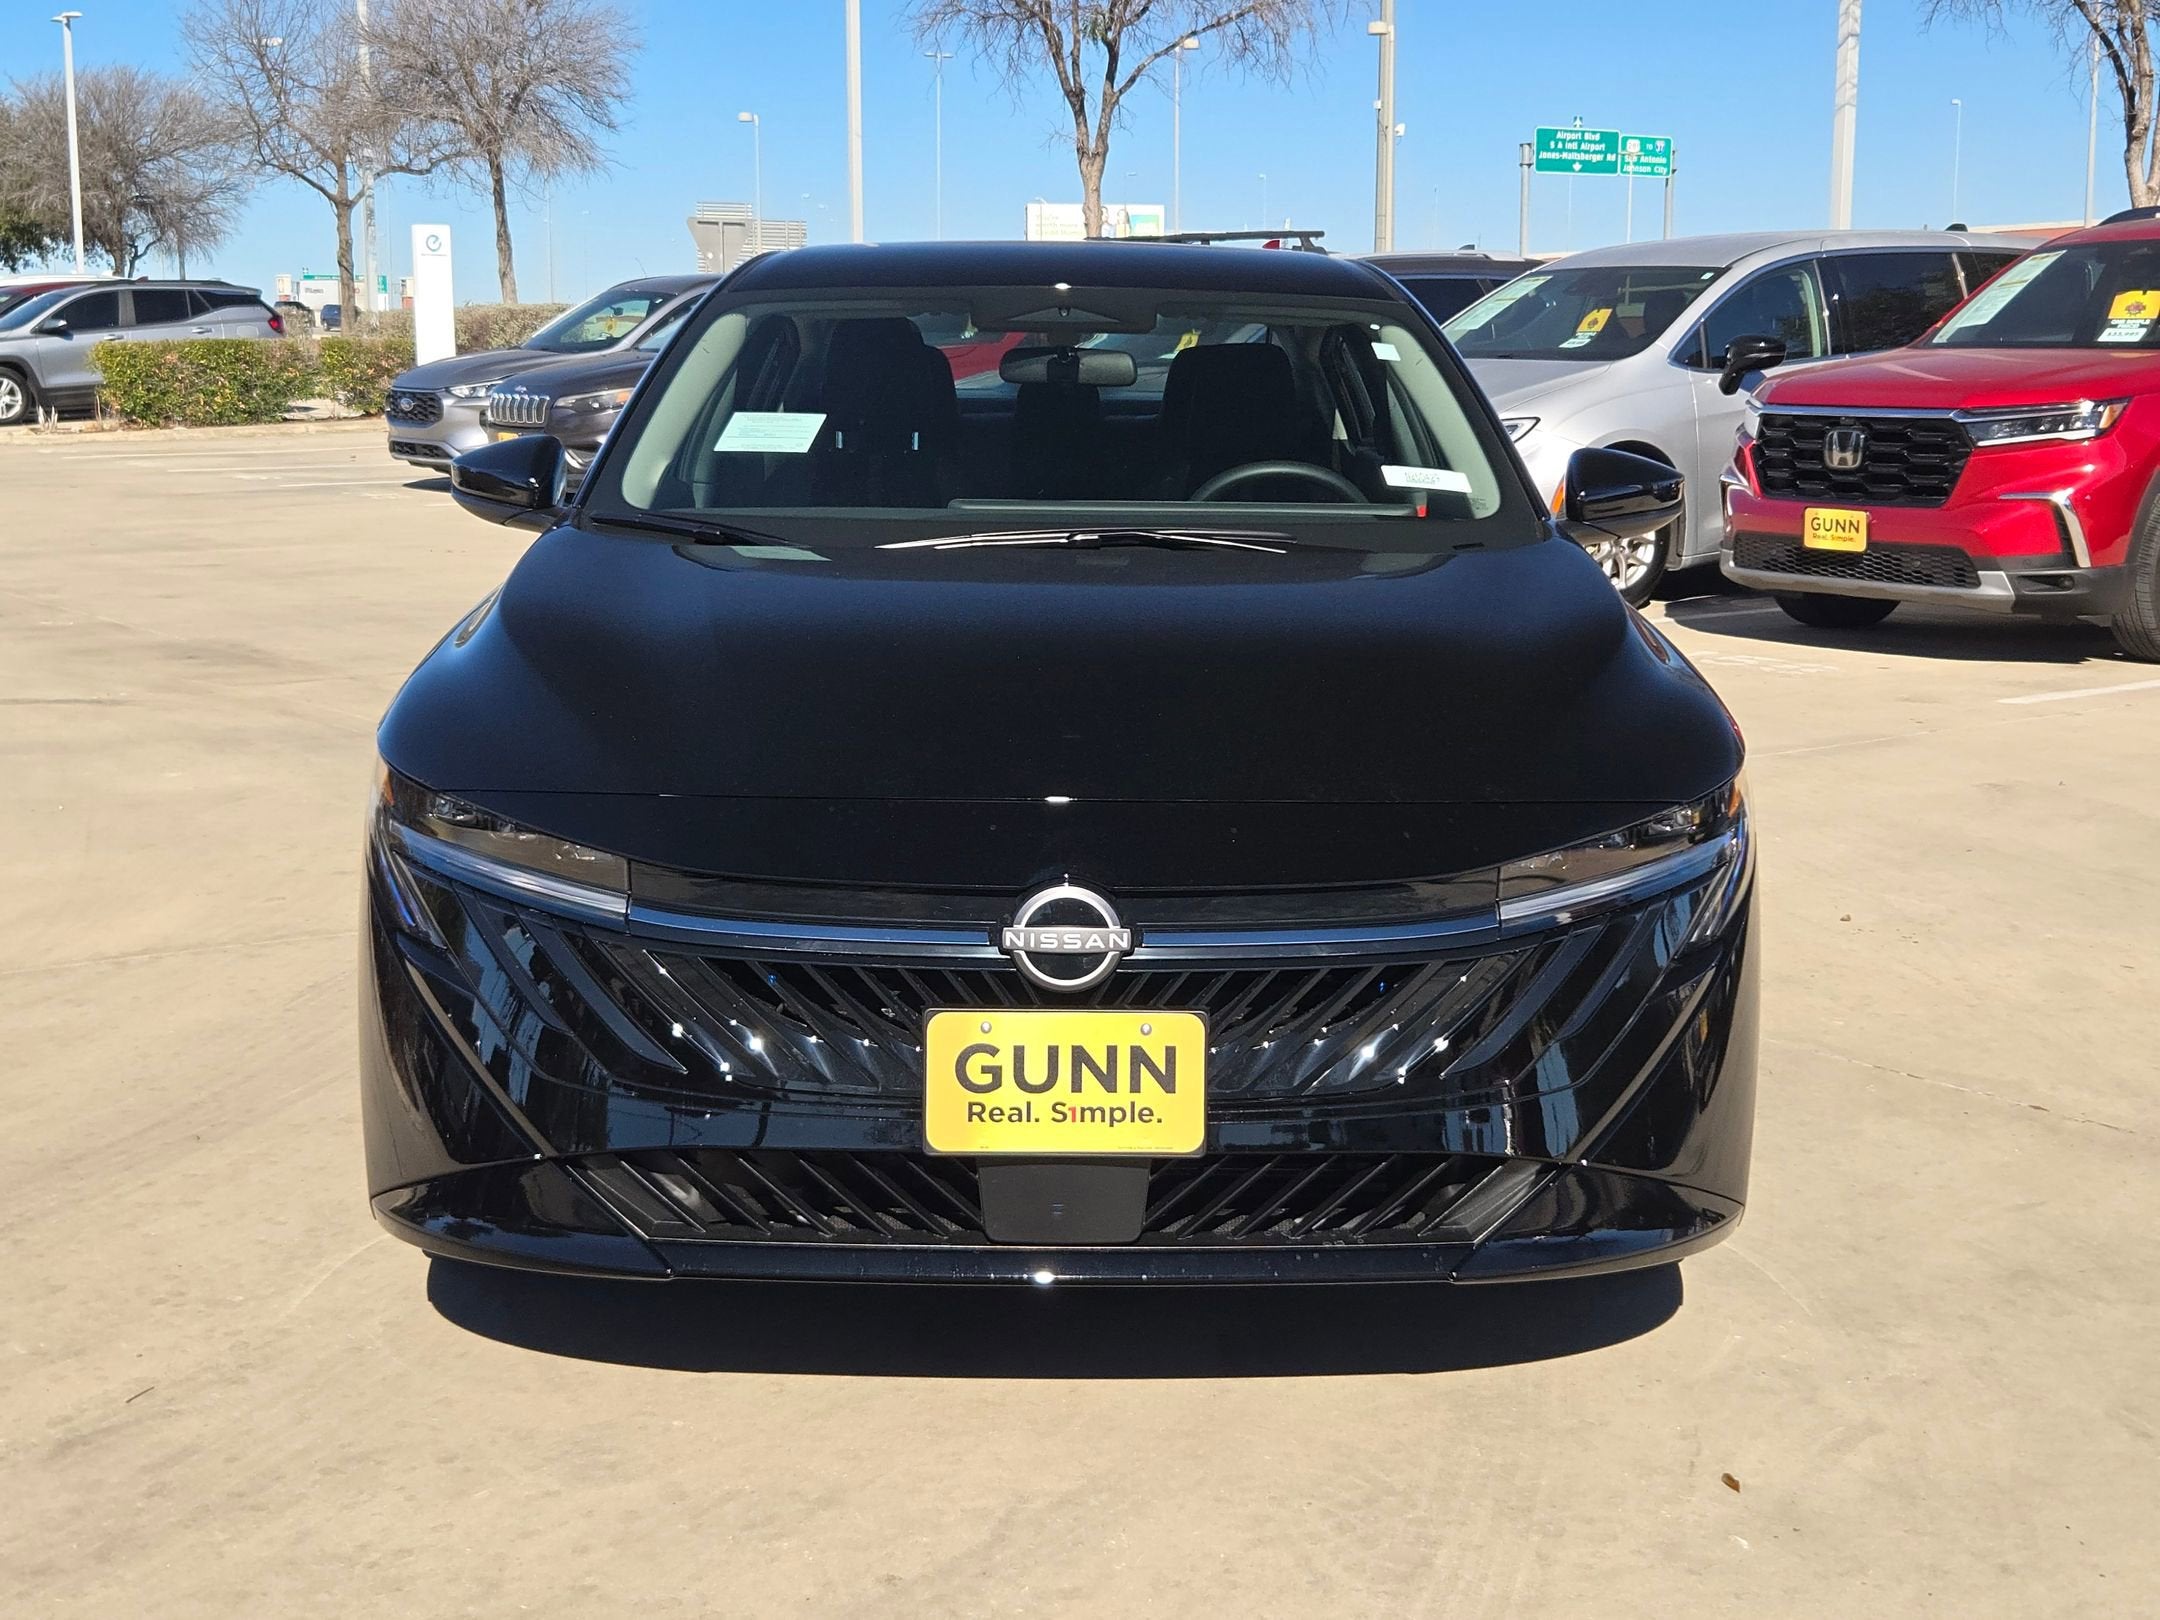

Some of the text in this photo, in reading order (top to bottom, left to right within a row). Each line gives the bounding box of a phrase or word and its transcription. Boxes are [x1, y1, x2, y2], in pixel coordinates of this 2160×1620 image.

[1556, 131, 1600, 141] Airport Blvd
[1550, 141, 1555, 149] S
[1557, 141, 1563, 149] A
[1580, 142, 1606, 152] Airport
[1607, 153, 1617, 161] Rd
[1640, 155, 1667, 164] Antonio
[1654, 165, 1668, 175] City
[1811, 516, 1860, 534] GUNN
[1005, 931, 1129, 949] NISSAN
[954, 1043, 1177, 1094] GUNN
[967, 1101, 1163, 1128] Real. S1mple.
